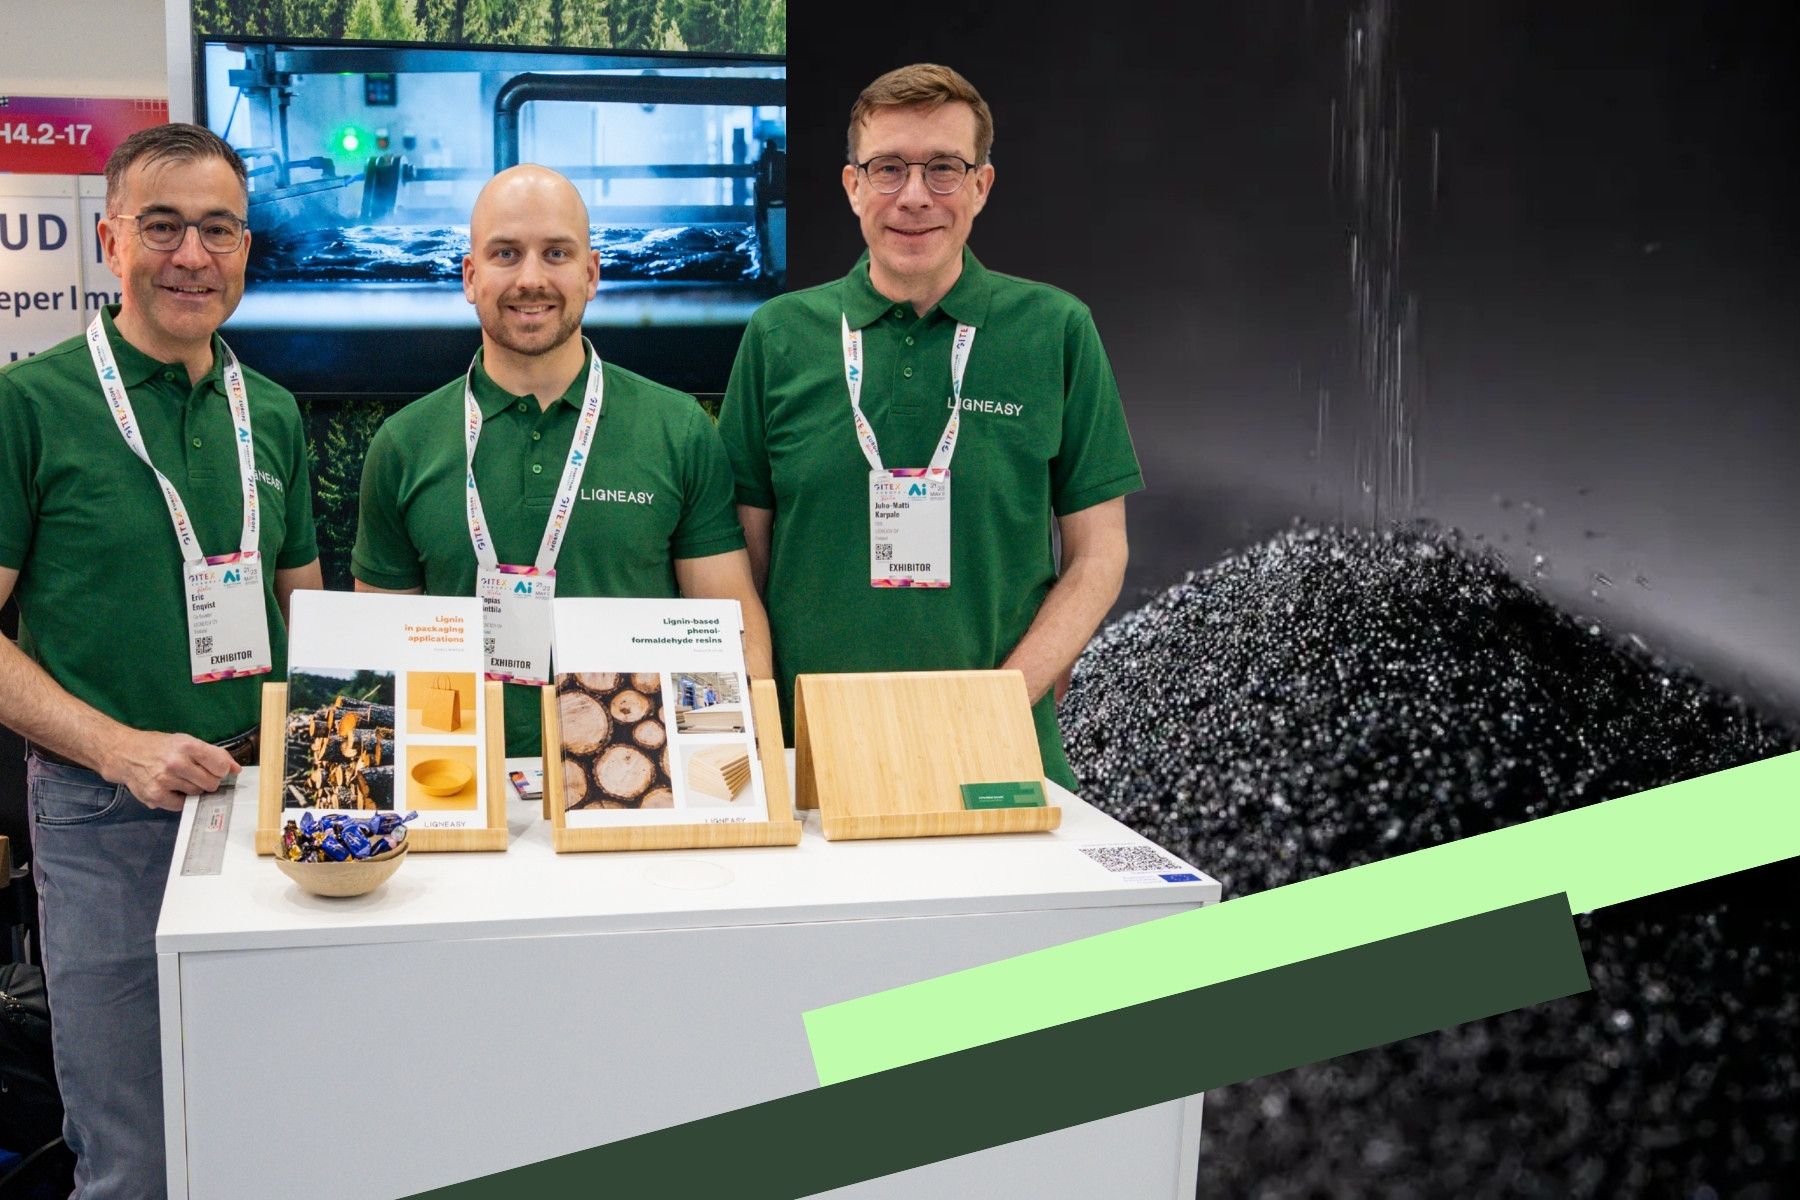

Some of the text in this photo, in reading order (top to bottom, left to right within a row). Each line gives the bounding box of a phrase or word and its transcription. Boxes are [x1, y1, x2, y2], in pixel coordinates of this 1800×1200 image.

[0, 213, 68, 251] UD
[947, 396, 1024, 417] LIGNEASY
[580, 488, 655, 505] LIGNEASY
[889, 563, 931, 572] EXHIBITOR
[481, 595, 501, 604] opias
[435, 615, 465, 624] Lignin
[663, 617, 720, 626] Lignin-based
[415, 625, 465, 634] packaging
[407, 635, 465, 643] applications
[631, 636, 723, 645] formaldehyde resins
[210, 650, 253, 665] EXHIBITOR
[490, 657, 532, 670] EXHIBITOR
